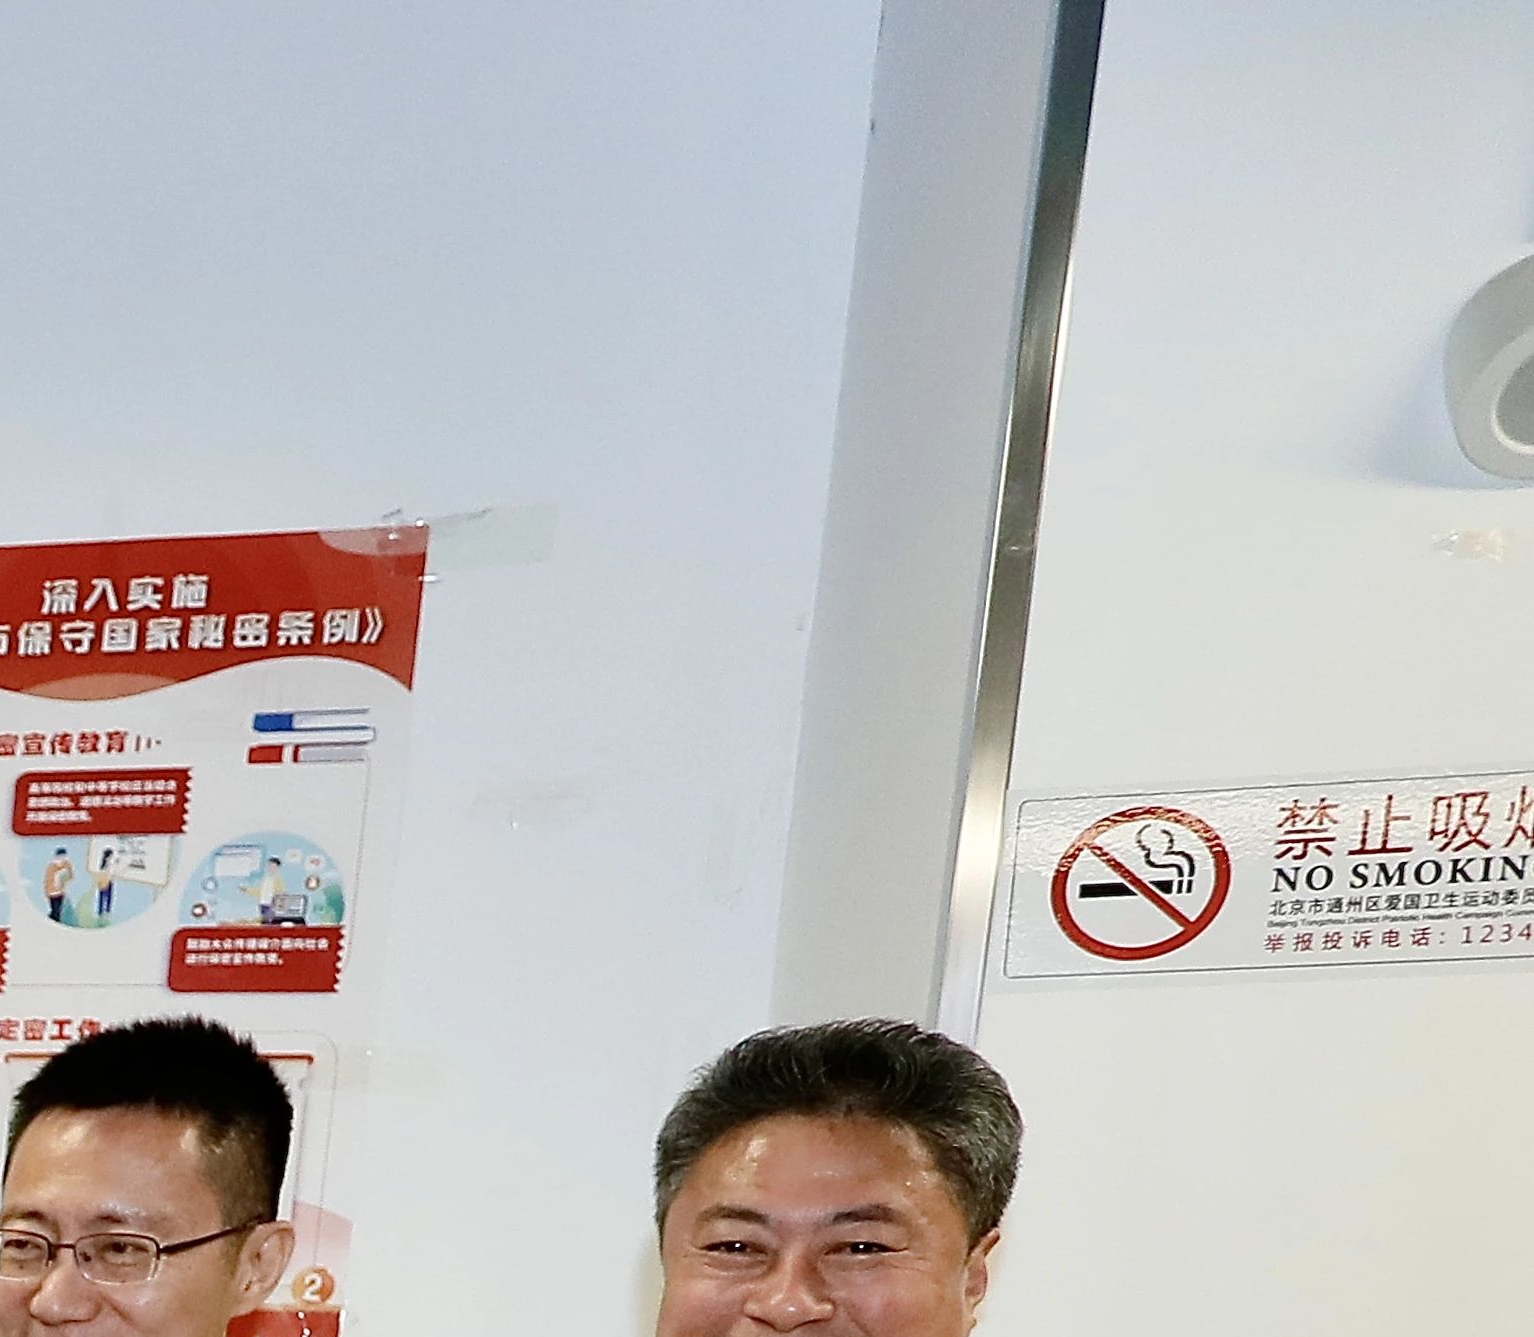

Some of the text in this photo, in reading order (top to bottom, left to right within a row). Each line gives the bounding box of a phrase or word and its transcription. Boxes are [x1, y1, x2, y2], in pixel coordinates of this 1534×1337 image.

[41, 572, 210, 616] 深入实施
[1270, 855, 1534, 893] NO SMOKIN
[301, 1272, 327, 1300] 2
